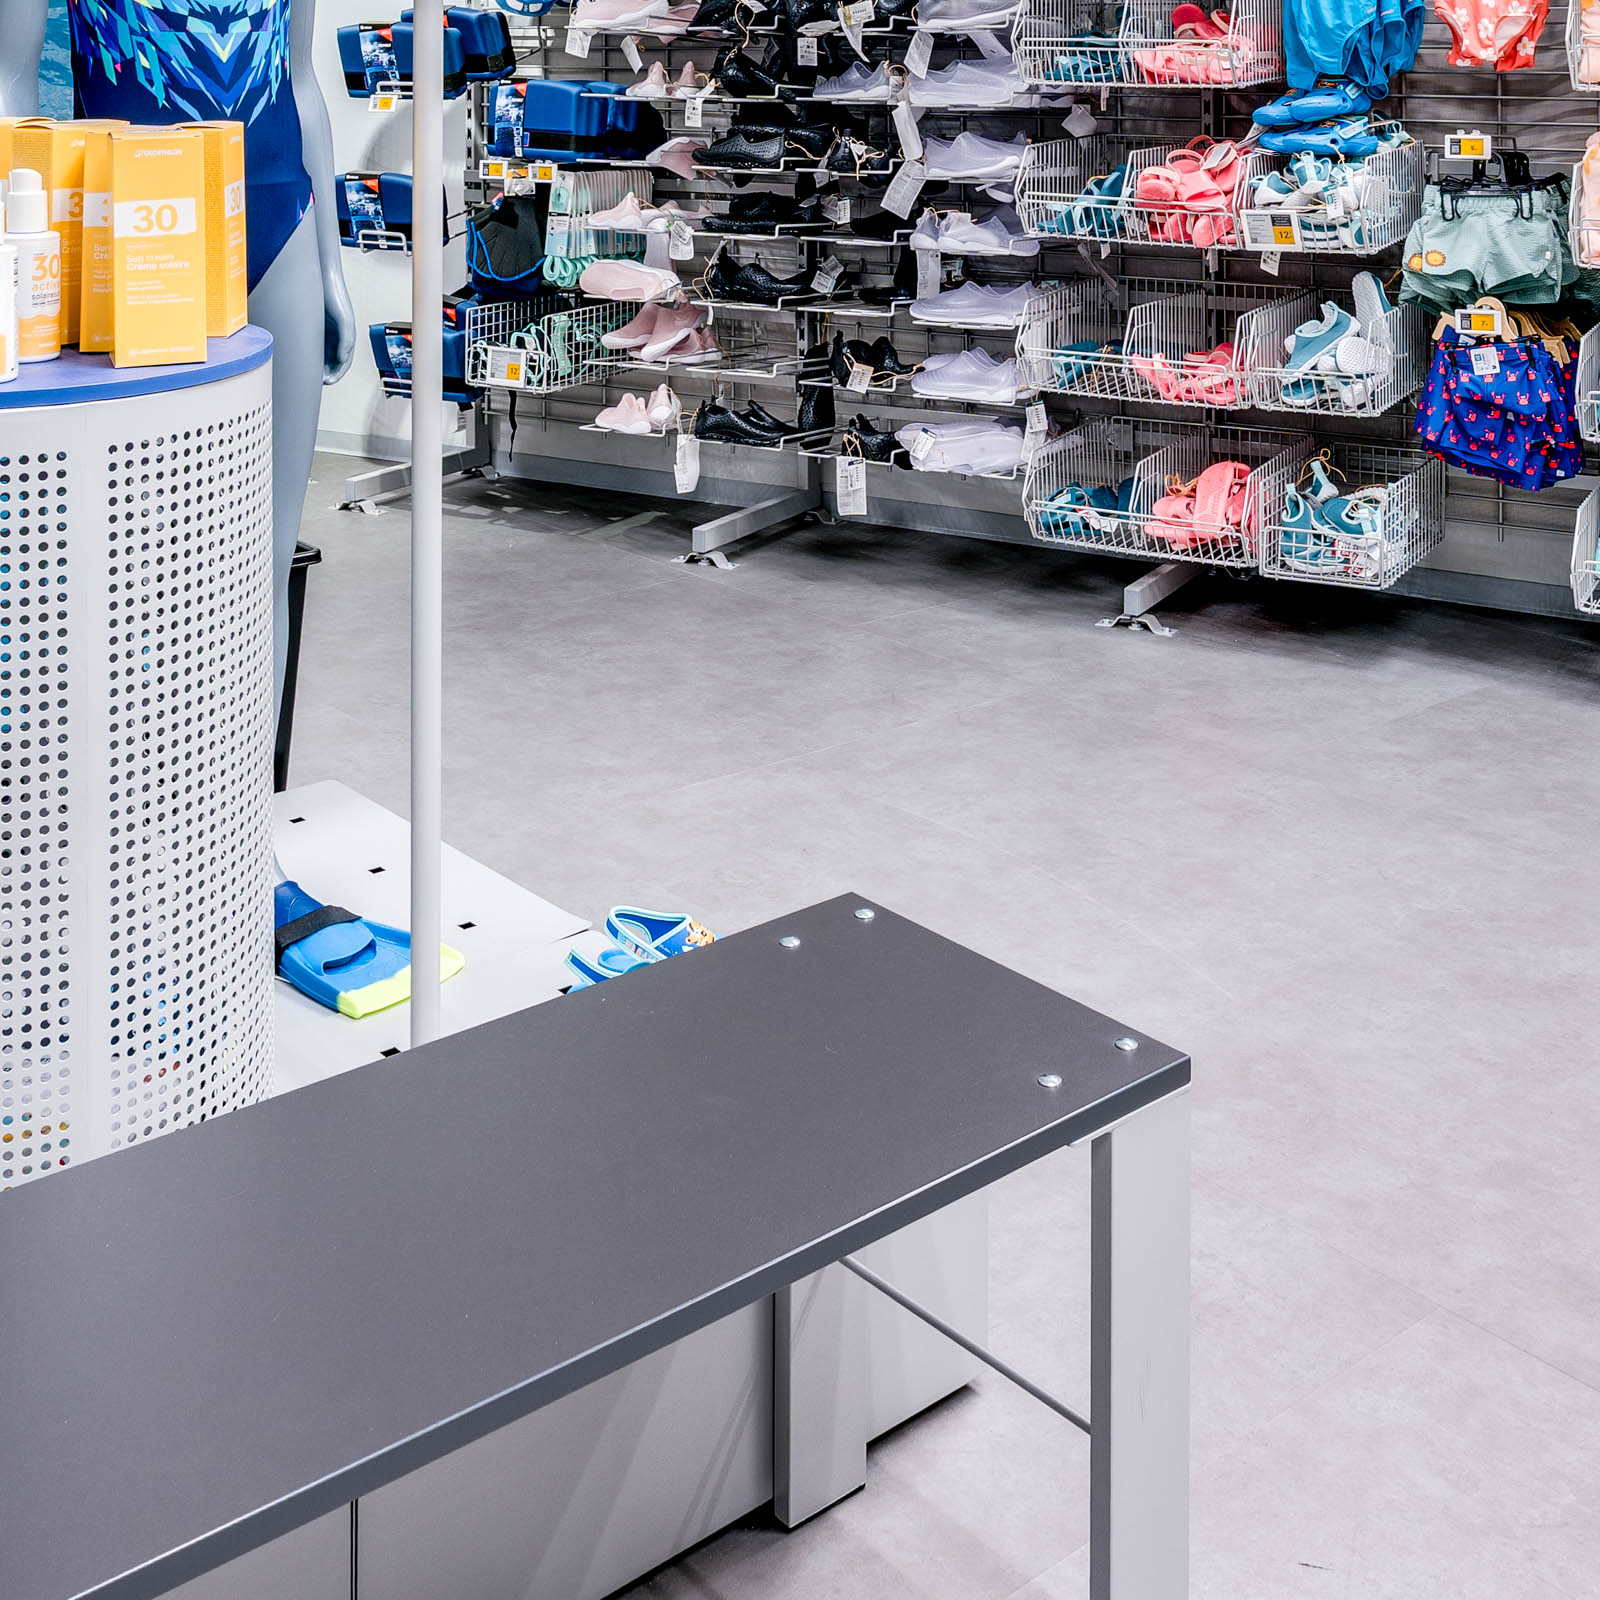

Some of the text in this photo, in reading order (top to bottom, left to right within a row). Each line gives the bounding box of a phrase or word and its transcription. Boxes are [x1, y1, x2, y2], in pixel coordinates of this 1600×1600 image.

[229, 184, 242, 213] 30
[132, 203, 179, 233] 30
[31, 252, 62, 280] 30
